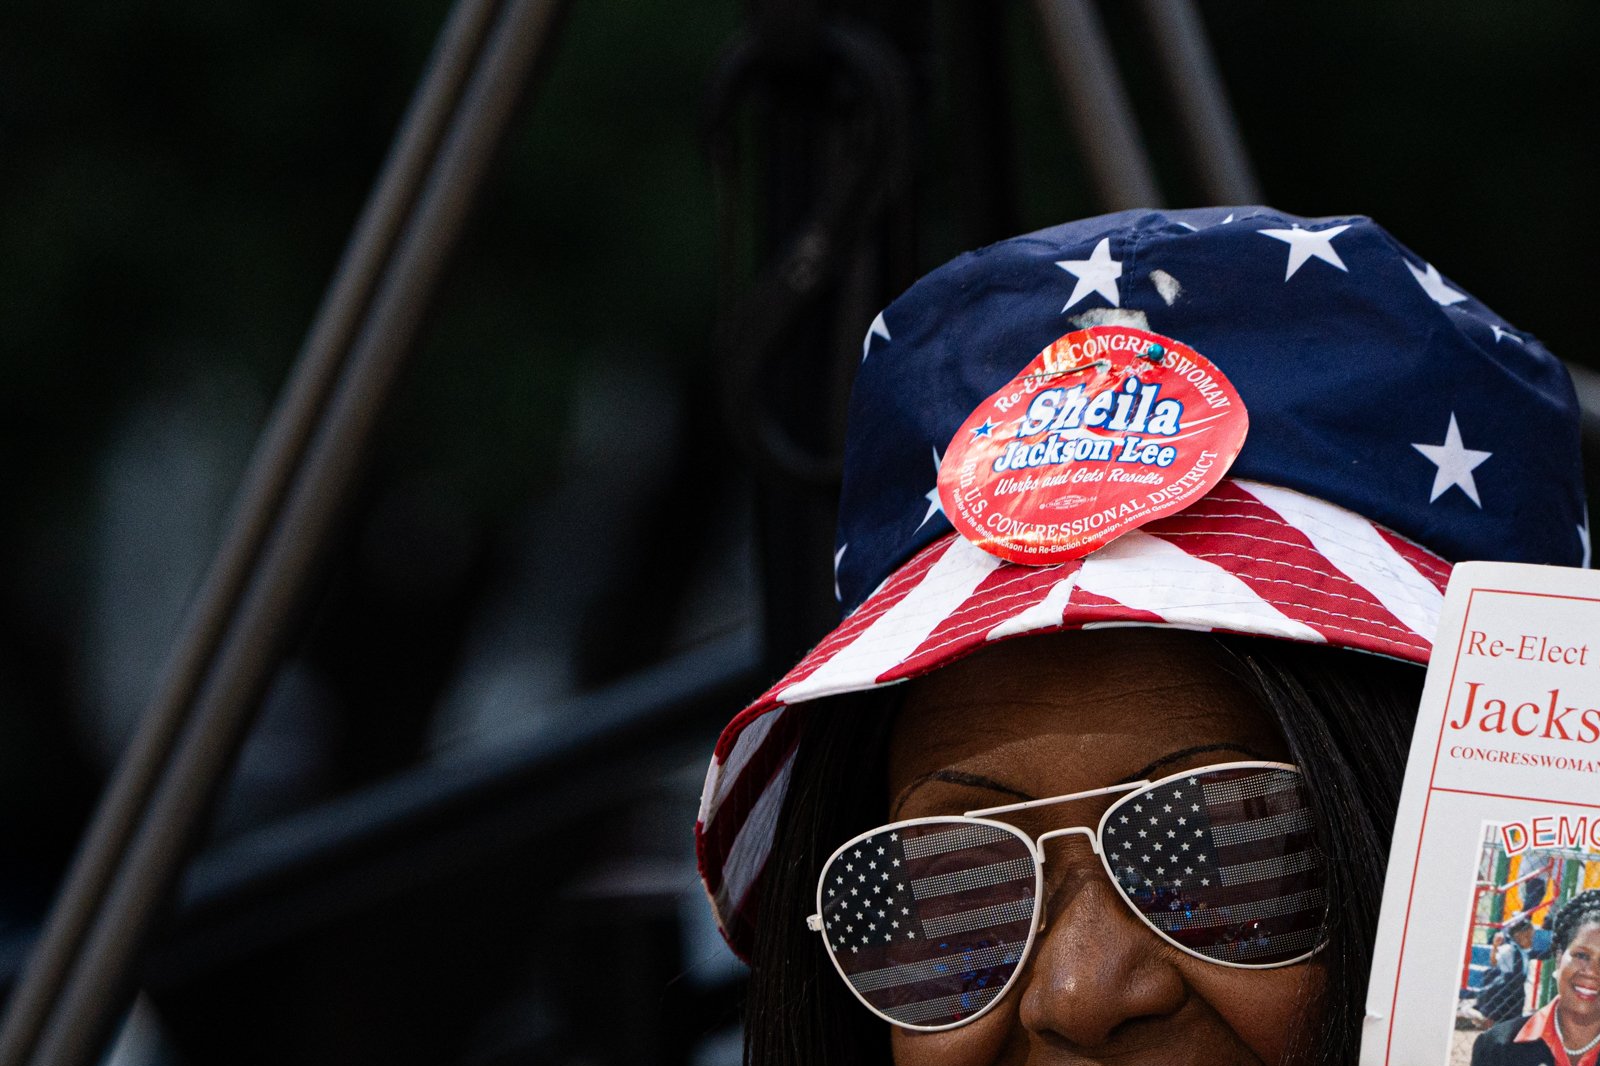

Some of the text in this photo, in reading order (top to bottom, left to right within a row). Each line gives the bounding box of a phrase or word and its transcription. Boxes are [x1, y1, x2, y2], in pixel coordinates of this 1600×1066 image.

[1069, 333, 1230, 409] CONGRESWOMAN
[1018, 376, 1184, 438] Sheila
[993, 434, 1178, 472] Jackson Lee
[960, 456, 979, 489] 18th
[994, 468, 1164, 496] Works and Gets Results
[1146, 450, 1218, 504] DISTRICT
[964, 487, 988, 518] U.S.
[986, 498, 1146, 541] CONGRESSIONAL
[1024, 545, 1038, 554] Lee
[1038, 541, 1080, 554] Re-Election
[1082, 522, 1122, 544] Campaign,
[1467, 630, 1590, 666] Re-Elect
